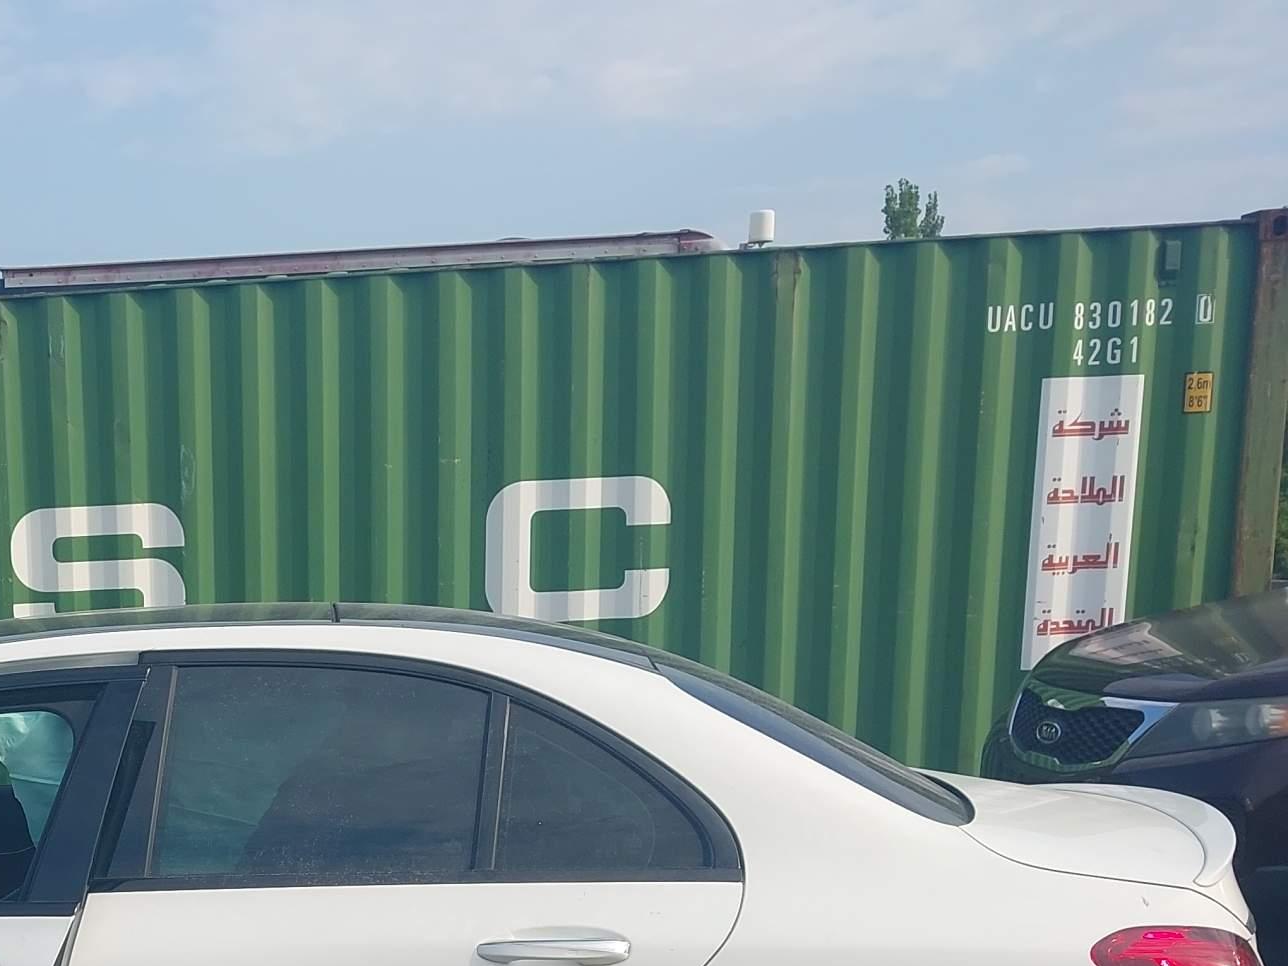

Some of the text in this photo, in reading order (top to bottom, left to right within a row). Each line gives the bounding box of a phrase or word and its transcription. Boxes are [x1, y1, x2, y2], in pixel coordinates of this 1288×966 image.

[987, 302, 1055, 333] UACU
[1073, 297, 1173, 331] 830182
[1072, 336, 1139, 366] 42G1
[1052, 408, 1130, 441] شركة
[1047, 475, 1125, 506] الملاحة
[1041, 542, 1119, 577] العربية
[1037, 607, 1114, 636] المتحدة
